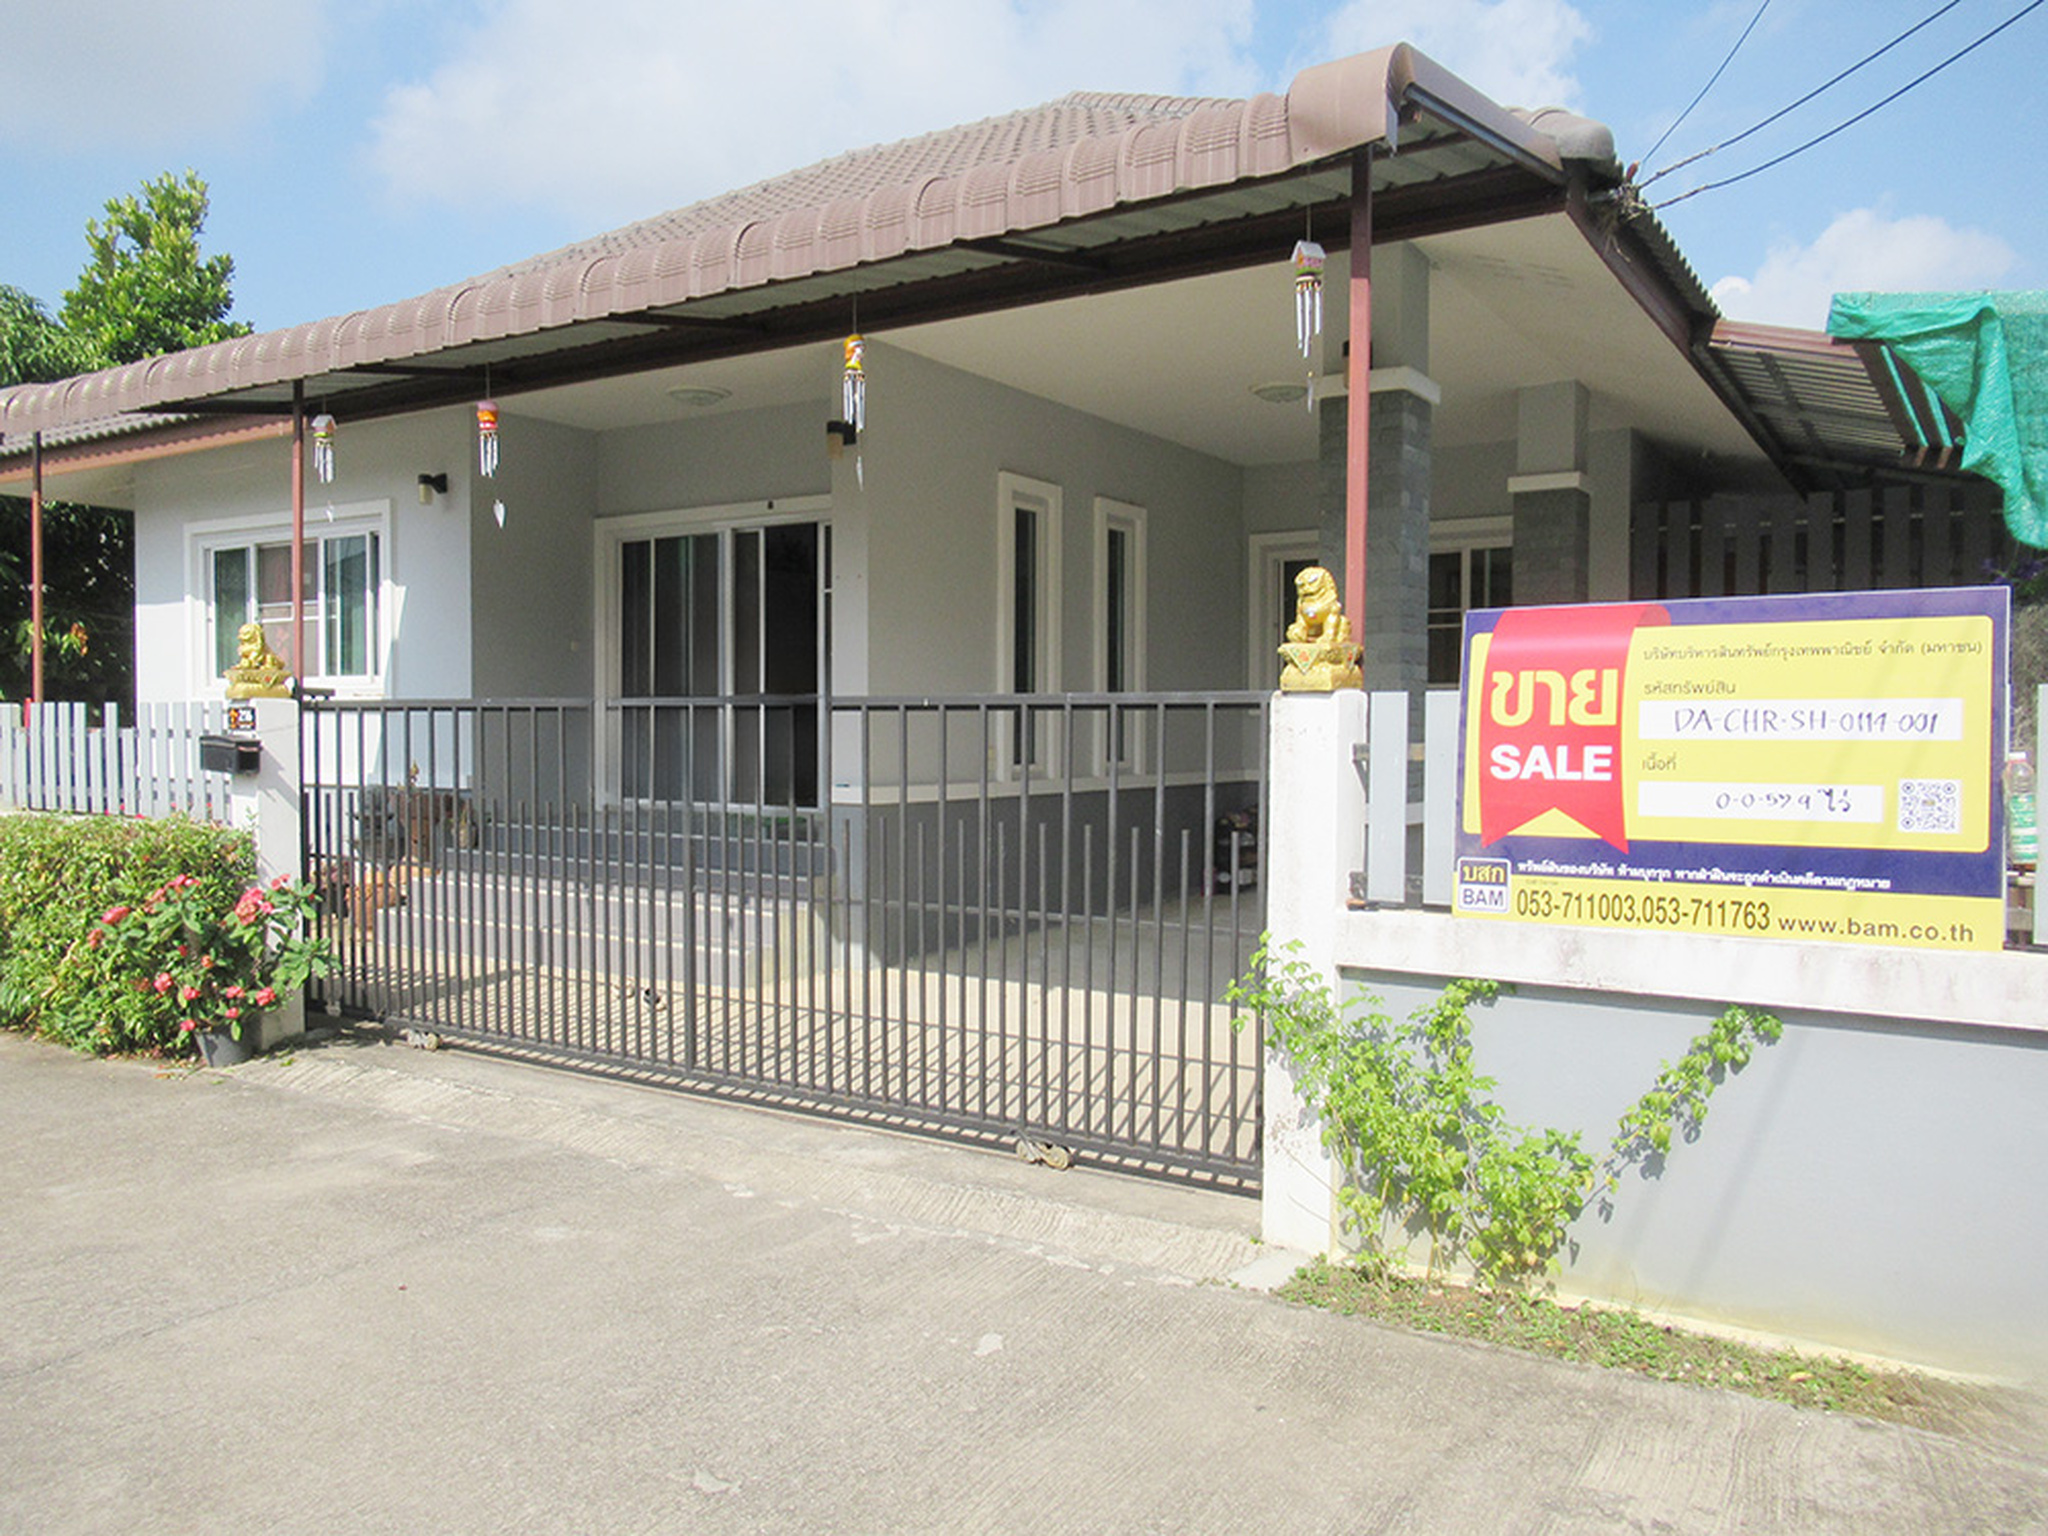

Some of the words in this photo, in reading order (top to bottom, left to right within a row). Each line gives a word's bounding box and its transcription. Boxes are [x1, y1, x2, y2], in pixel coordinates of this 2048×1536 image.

[1879, 639, 1915, 655] จำกัด
[1920, 640, 1983, 656] (มหาชน)
[1643, 678, 1736, 695] รหัสทรัพย์สิน
[1491, 669, 1619, 727] ขาย
[1490, 743, 1613, 781] SALE
[1641, 751, 1677, 771] เนื้อที่
[1462, 863, 1505, 884] บสก
[1462, 888, 1504, 908] BAM
[1779, 917, 1973, 942] www.bam.co.th
